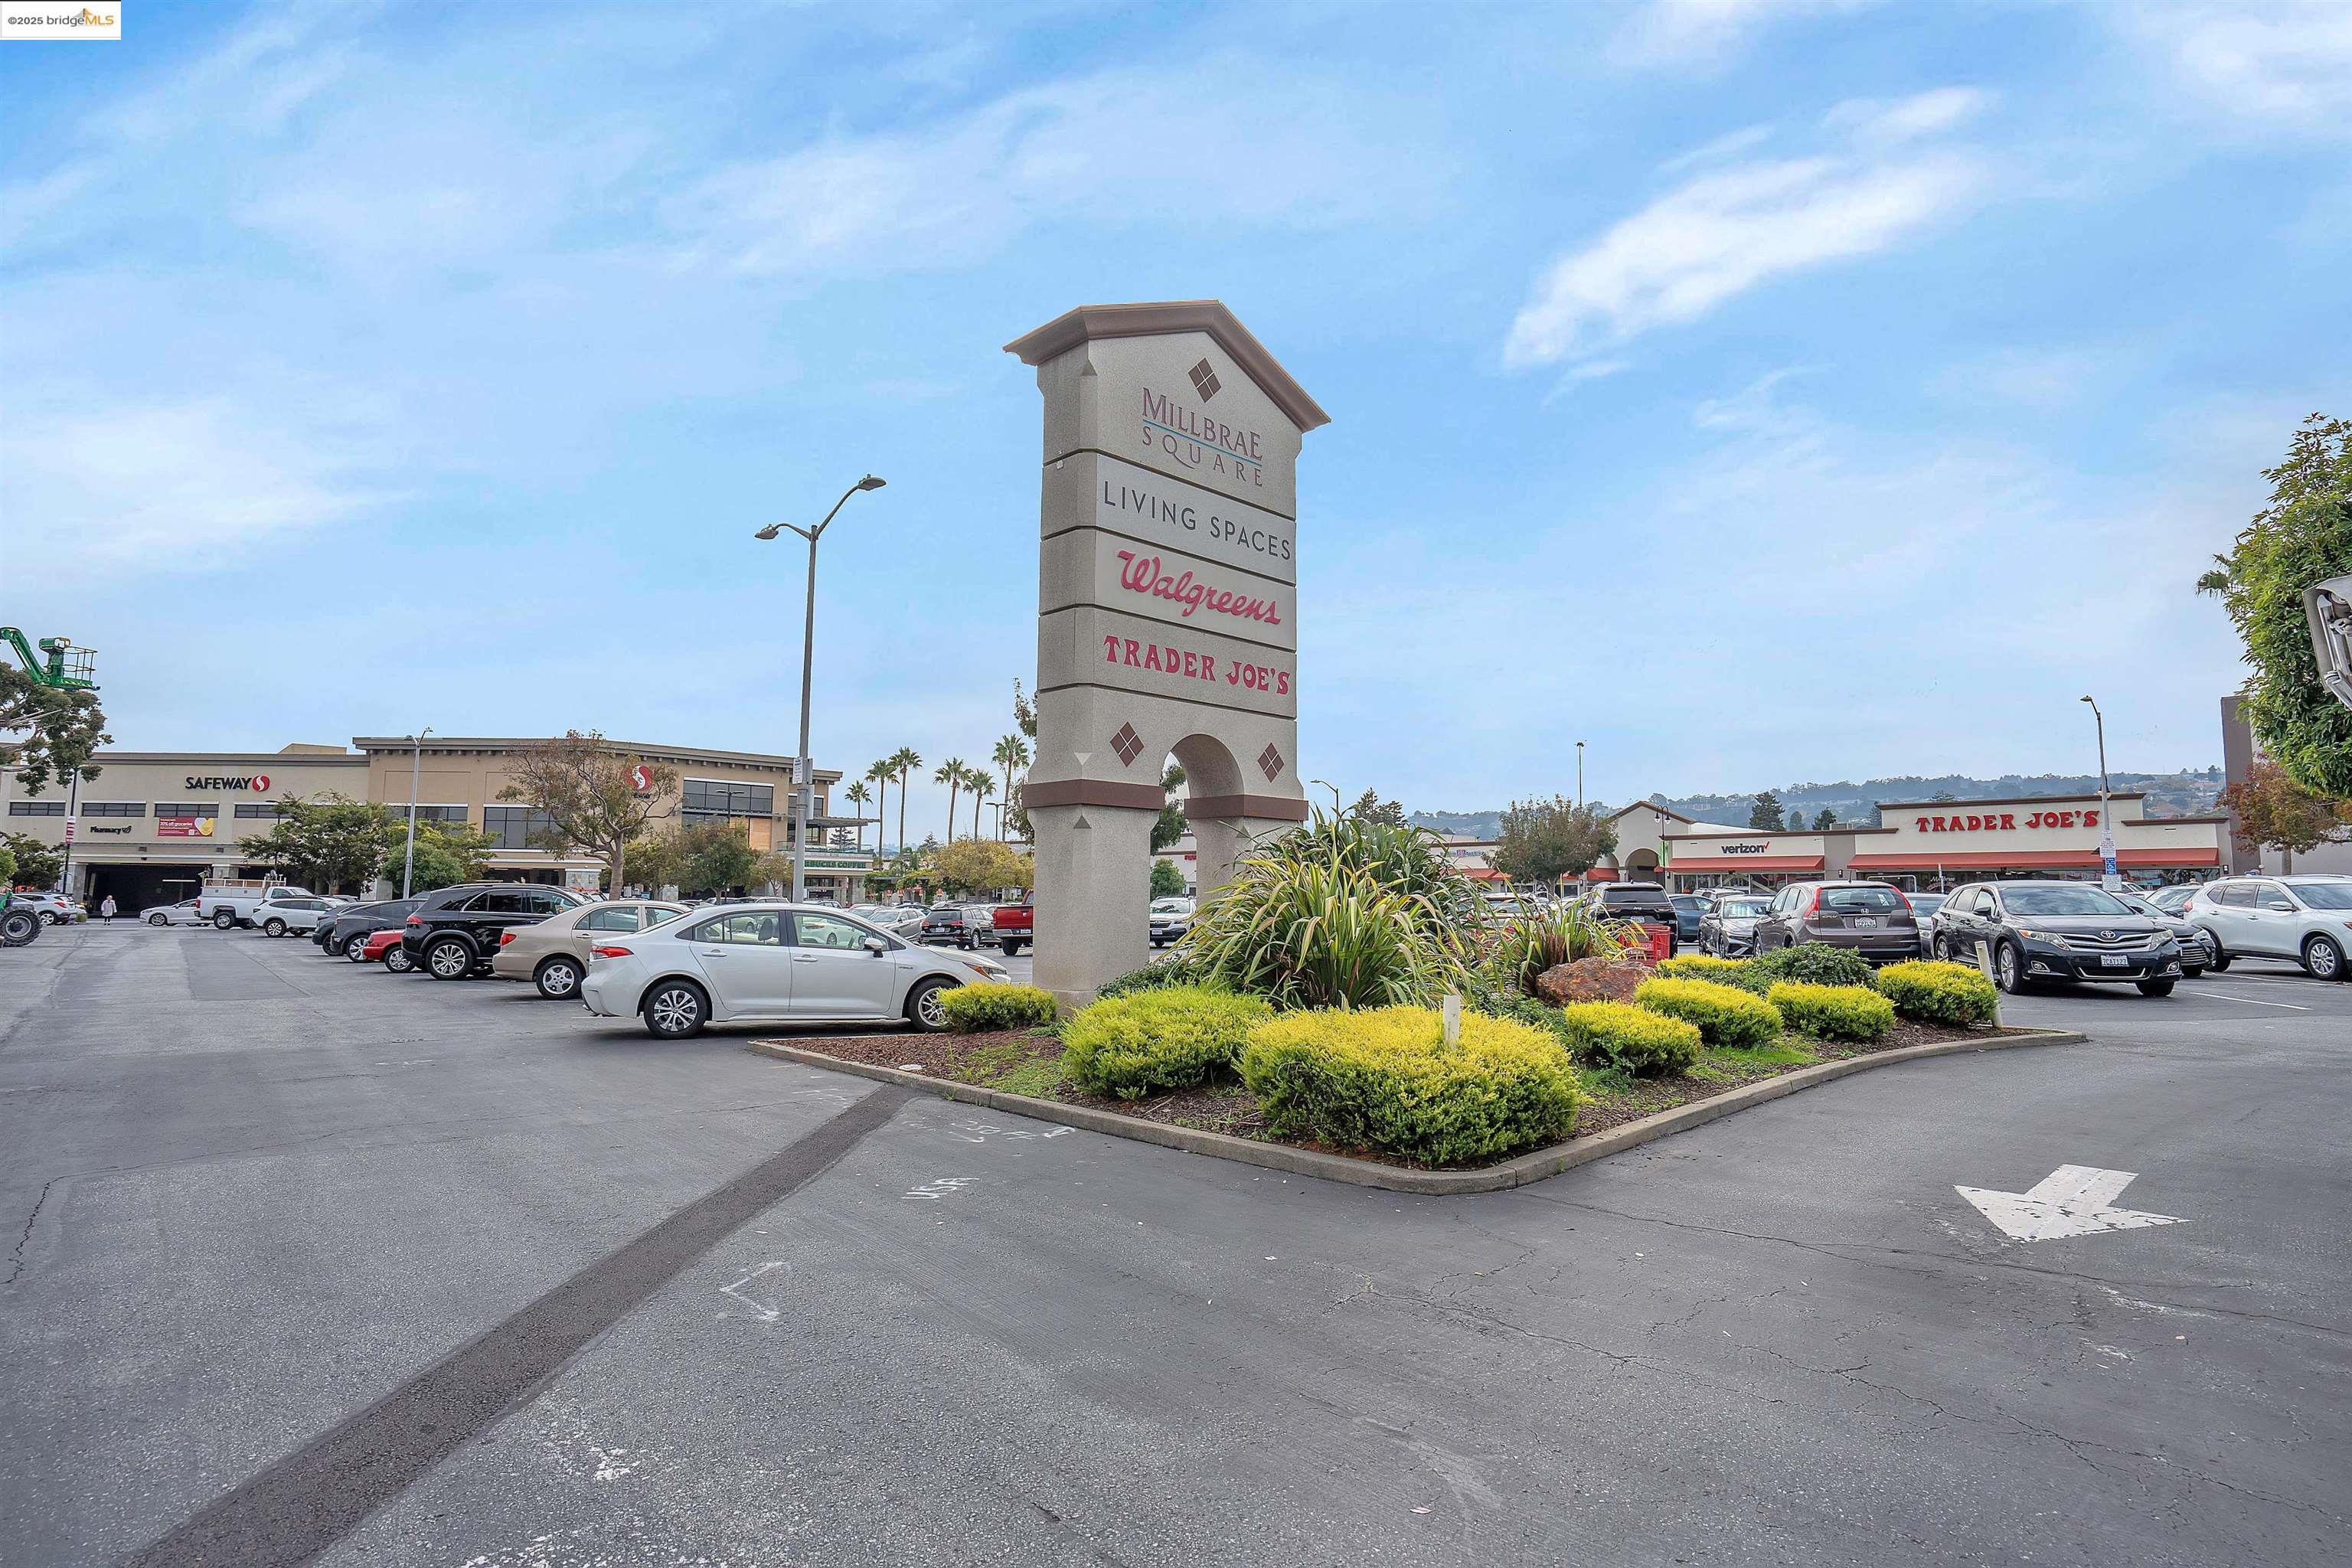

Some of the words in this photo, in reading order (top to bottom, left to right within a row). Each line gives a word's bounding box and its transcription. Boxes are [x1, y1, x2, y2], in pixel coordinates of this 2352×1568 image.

[1142, 386, 1263, 462] MILLBRAE
[1142, 425, 1263, 488] SQUARE
[1103, 481, 1197, 531] LIVING
[1210, 515, 1291, 560] SPACES
[1116, 550, 1282, 626] Walgreens
[1103, 635, 1217, 681] TRADER
[1225, 661, 1291, 695] JOE'S
[185, 776, 252, 790] SAFEWAY
[90, 825, 122, 835] Pharmacy
[1916, 814, 2017, 833] TRADER
[2024, 809, 2100, 828] JOE'S
[1720, 843, 1765, 854] verizon
[900, 1178, 981, 1199] USA
